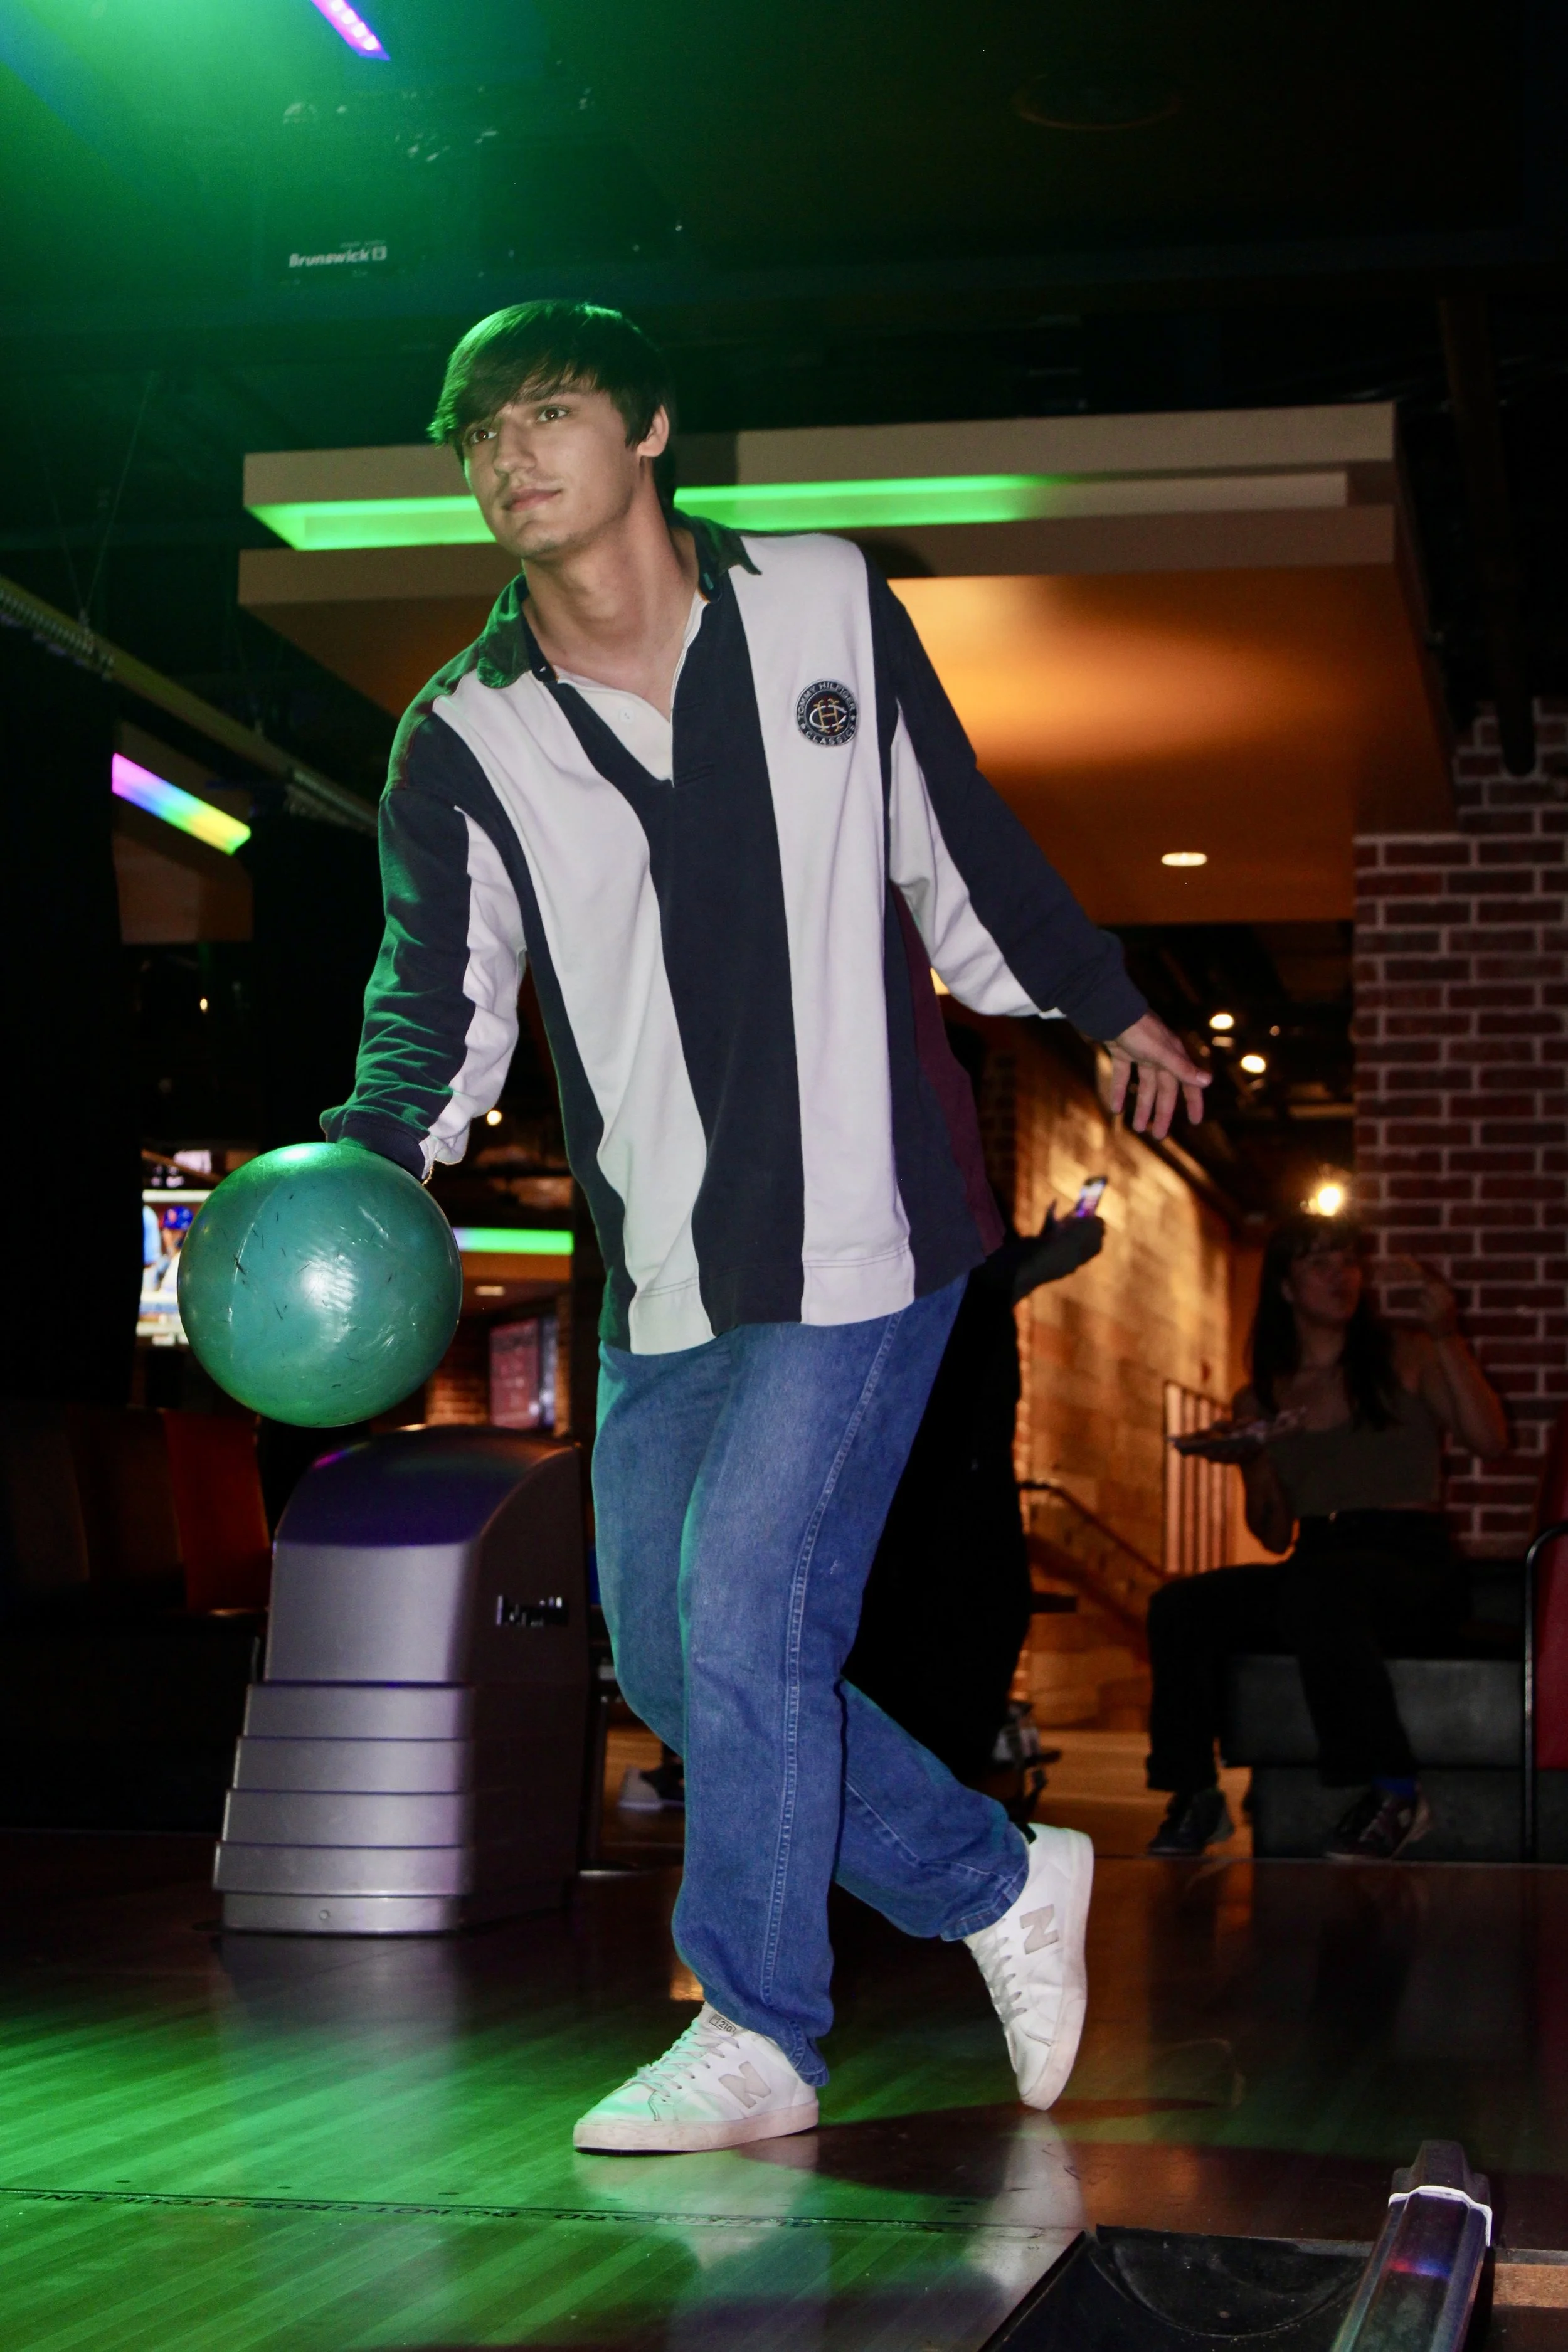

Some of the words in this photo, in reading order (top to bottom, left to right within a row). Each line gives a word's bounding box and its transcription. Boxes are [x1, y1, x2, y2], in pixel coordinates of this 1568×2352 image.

[289, 248, 369, 268] Brunswick
[797, 685, 816, 721] TOMMY
[805, 723, 856, 745] CLASSICS
[1019, 1903, 1060, 1955] N
[718, 2021, 733, 2032] 210
[718, 2060, 772, 2109] N
[19, 2194, 103, 2202] LINE
[226, 2201, 358, 2212] CROSS
[368, 2207, 452, 2215] NOT
